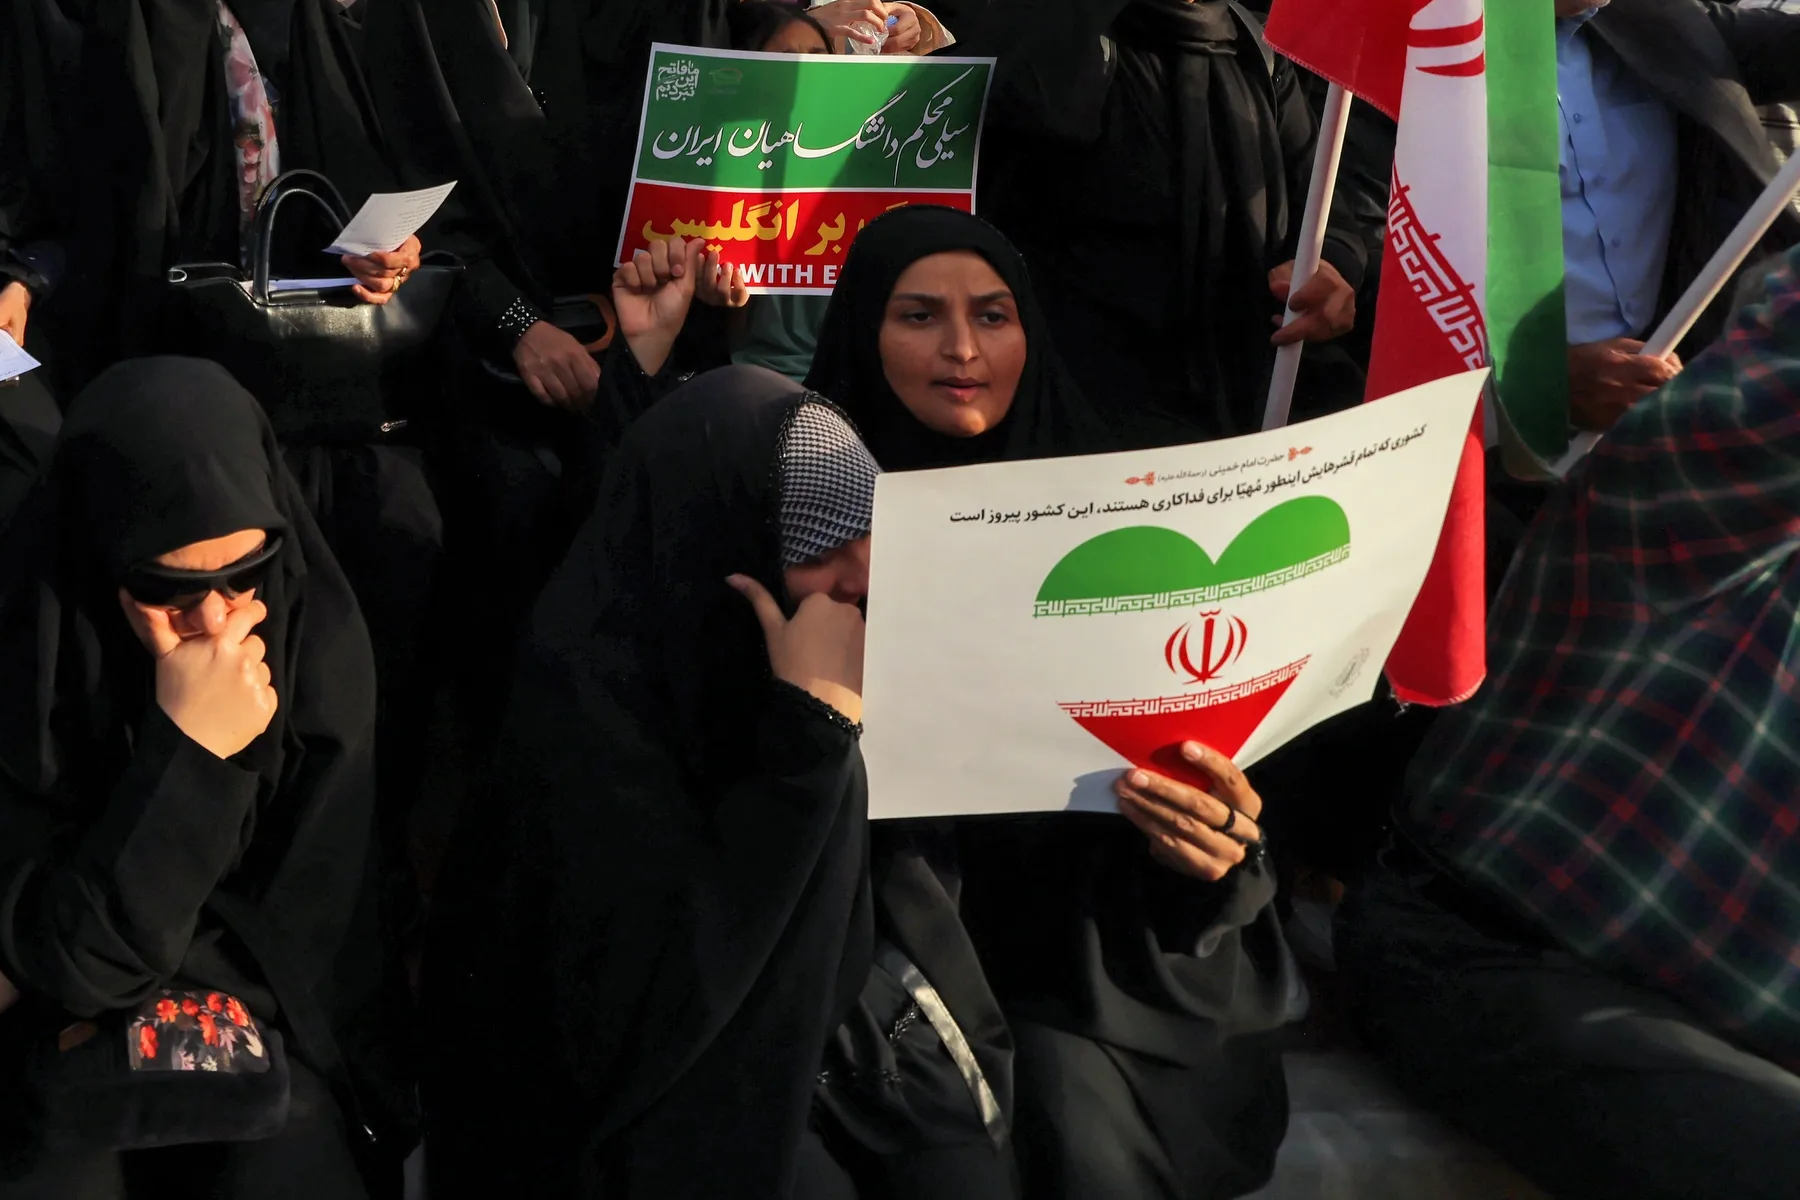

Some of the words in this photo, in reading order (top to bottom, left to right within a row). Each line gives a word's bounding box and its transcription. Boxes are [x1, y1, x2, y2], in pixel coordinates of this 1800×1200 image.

[727, 89, 907, 171] دانشگاهیان
[893, 65, 975, 186] محکم
[652, 121, 723, 168] ایران
[914, 116, 971, 170] سیلی
[642, 198, 800, 254] انگلیس
[804, 212, 847, 256] بر
[740, 263, 814, 284] WITH
[1378, 436, 1390, 452] که
[1391, 423, 1427, 450] کشوری
[1240, 458, 1256, 474] امام
[1256, 454, 1284, 466] حضرت
[1355, 445, 1377, 466] تمام
[1208, 464, 1239, 477] خمینی
[1301, 451, 1355, 484] قشرهایش
[1263, 470, 1301, 494] اینطور
[1151, 490, 1205, 513] فداکاری
[1206, 486, 1234, 505] برای
[949, 509, 984, 523] است
[986, 510, 1021, 524] پیروز
[1024, 503, 1065, 522] کشور
[1067, 502, 1094, 519] این
